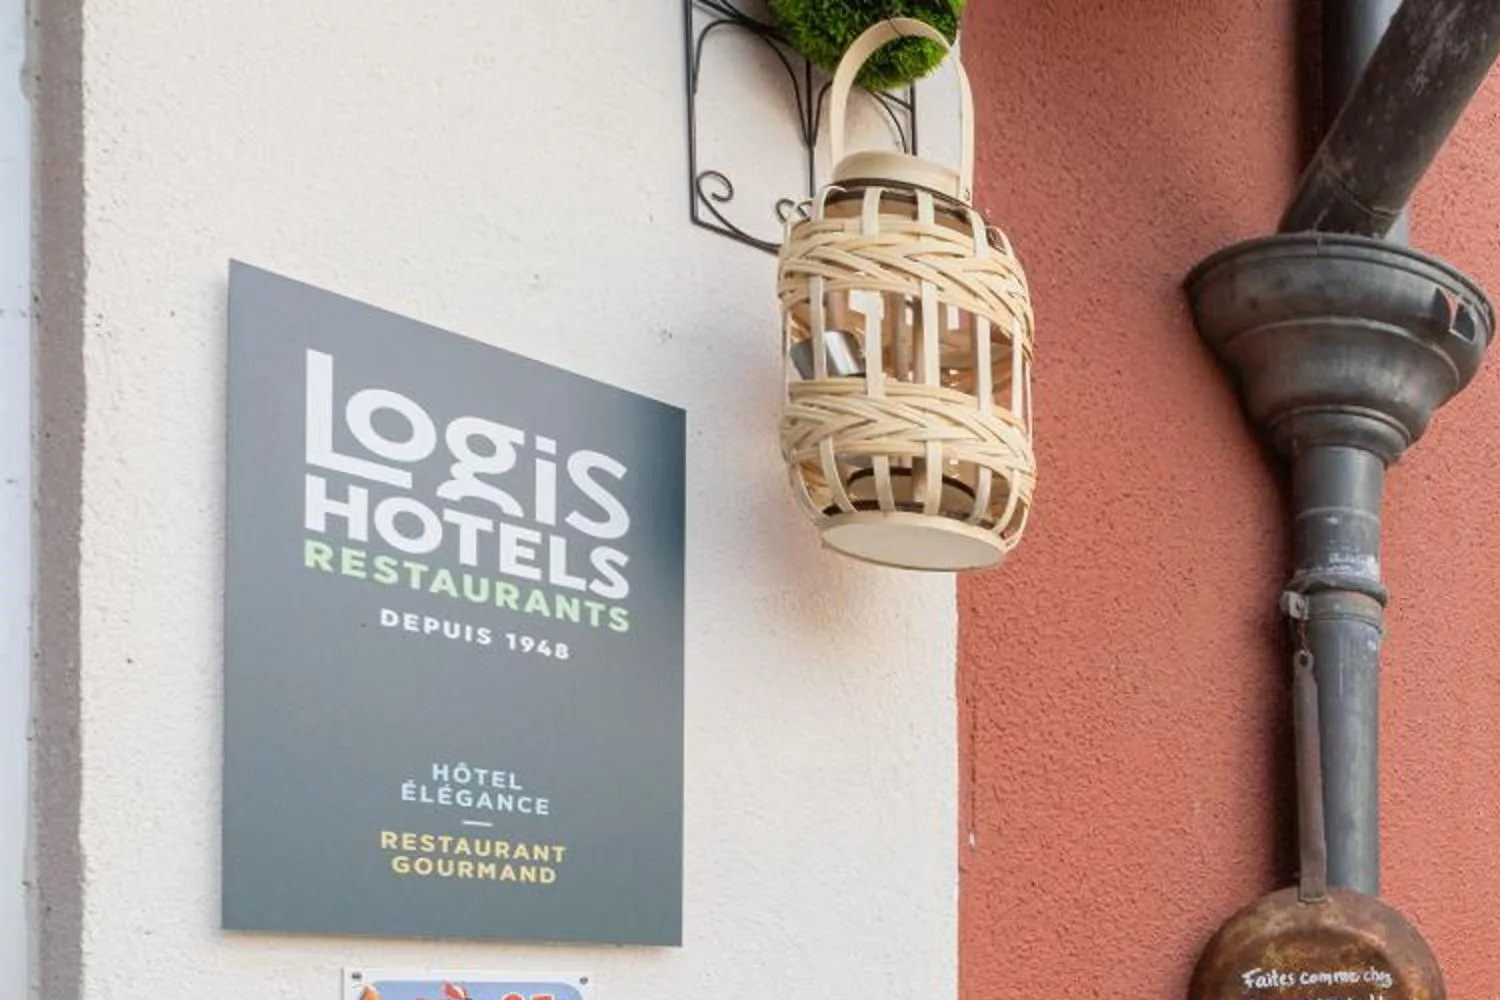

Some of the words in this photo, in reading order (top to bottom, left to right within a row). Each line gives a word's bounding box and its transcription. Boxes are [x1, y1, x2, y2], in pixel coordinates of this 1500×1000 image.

[305, 474, 630, 599] HOTELS
[304, 539, 630, 633] RESTAURANTS
[380, 608, 492, 645] DEPUIS
[505, 632, 570, 659] 1948
[432, 762, 523, 790] HÔTEL
[401, 780, 549, 815] ÉLÉGANCE
[380, 831, 566, 862] RESTAURANT
[391, 856, 556, 884] GOURMAND
[1241, 968, 1296, 989] Faites
[1300, 971, 1360, 986] comme
[1363, 967, 1393, 988] chez
